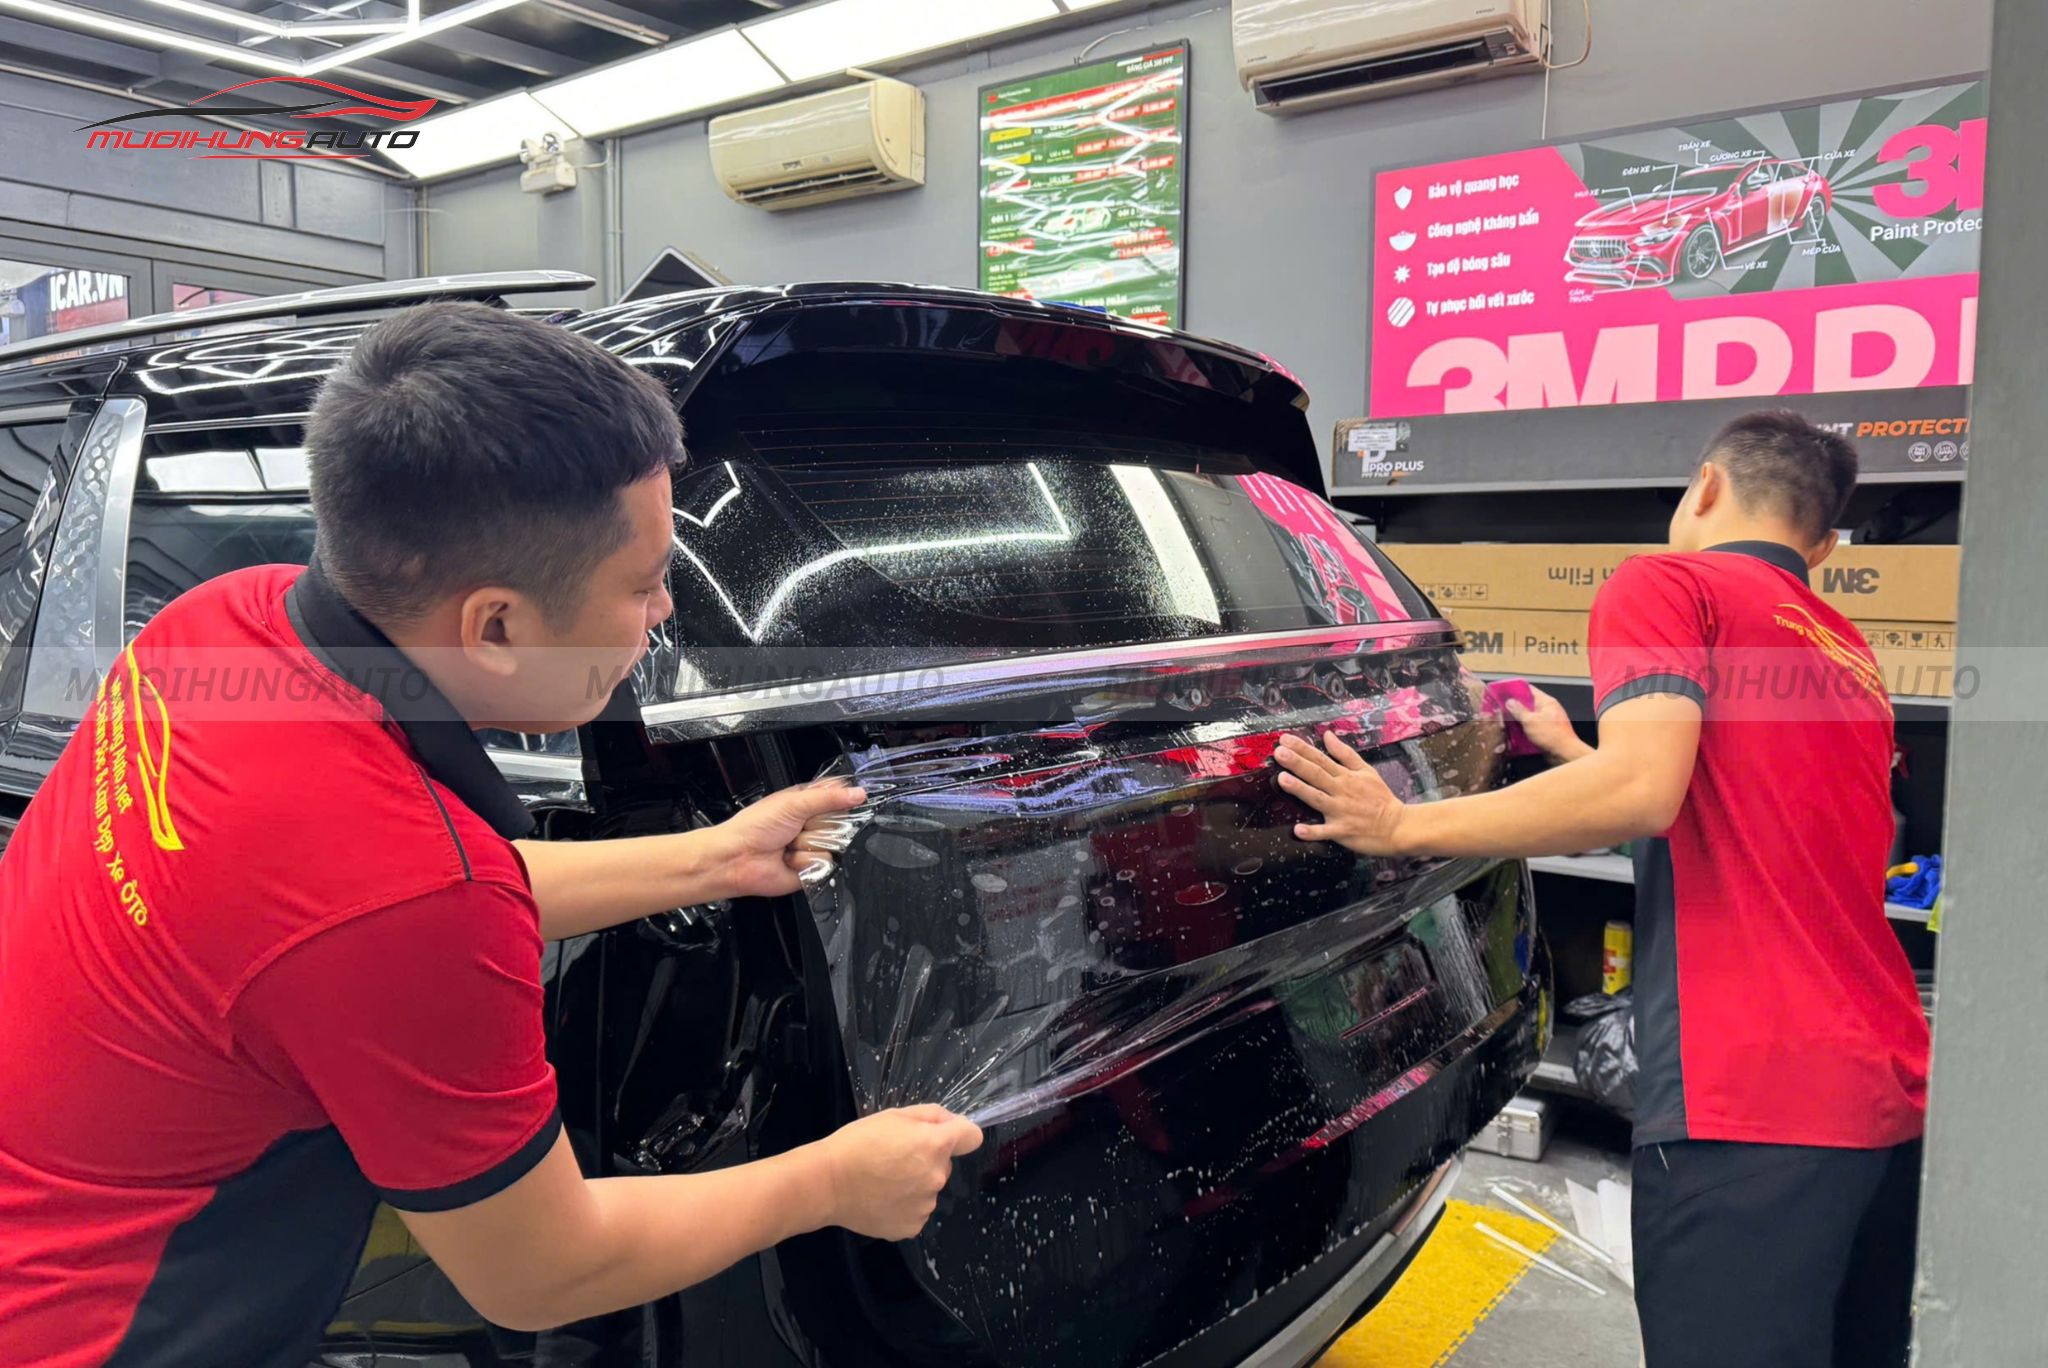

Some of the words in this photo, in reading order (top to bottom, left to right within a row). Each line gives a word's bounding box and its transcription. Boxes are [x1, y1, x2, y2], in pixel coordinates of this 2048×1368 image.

[1844, 149, 1856, 157] XE
[1640, 165, 1651, 174] XE
[1449, 180, 1462, 197] vệ
[1464, 178, 1497, 195] quang
[1498, 174, 1520, 190] học
[1455, 217, 1481, 234] nghệ
[1483, 214, 1516, 231] kháng
[1870, 223, 1919, 241] Paint
[1426, 262, 1445, 278] Tạo
[1446, 257, 1460, 275] độ
[1462, 256, 1489, 271] bóng
[1490, 252, 1511, 268] sâu
[1425, 301, 1439, 316] Tự
[1441, 299, 1467, 315] phục
[1468, 294, 1486, 310] hồi
[1487, 291, 1505, 308] vết
[1507, 289, 1535, 306] xước
[1370, 461, 1393, 472] PRO
[1394, 460, 1424, 471] PLUS
[1548, 567, 1594, 586] Film
[1823, 568, 1880, 594] 3M
[1463, 631, 1504, 654] 3M
[1524, 636, 1579, 655] Paint
